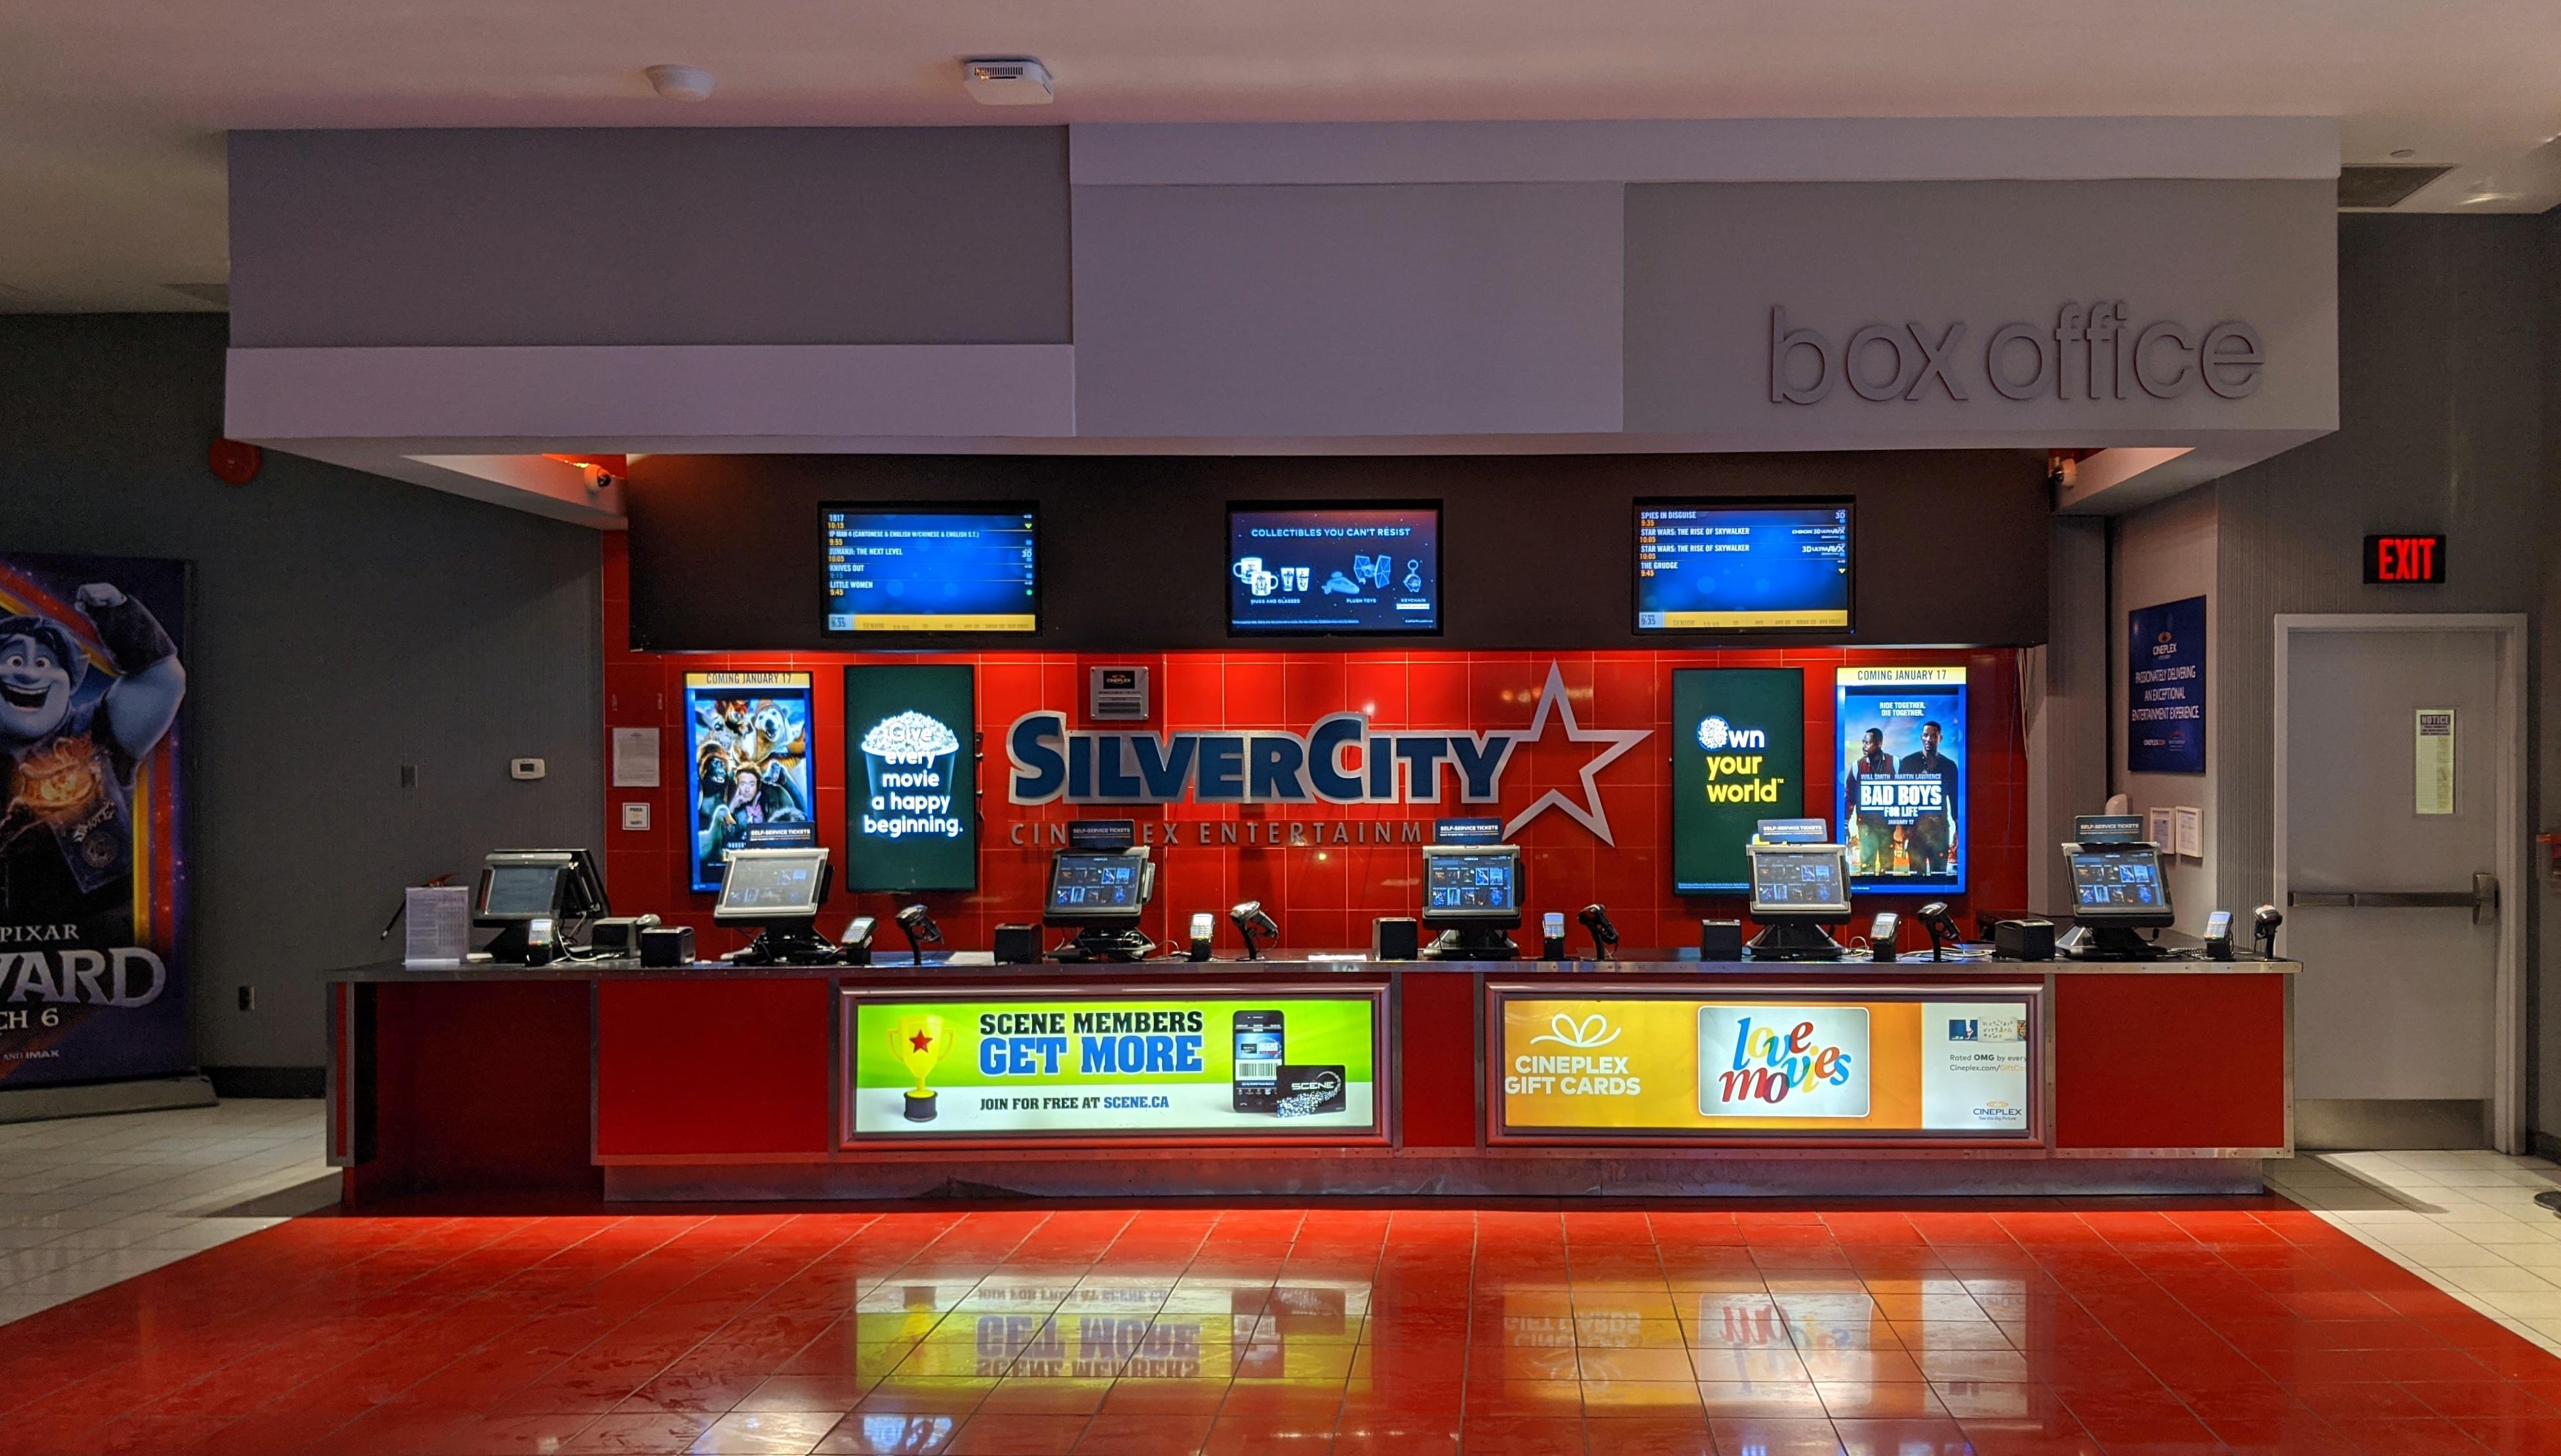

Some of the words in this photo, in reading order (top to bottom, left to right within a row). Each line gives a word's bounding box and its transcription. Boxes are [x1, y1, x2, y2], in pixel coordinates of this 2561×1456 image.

[1770, 303, 1969, 404] box
[1987, 301, 2265, 401] office
[2379, 538, 2436, 580] EXIT
[2153, 643, 2177, 656] CINEPLEX
[707, 673, 740, 684] COMING
[742, 673, 778, 684] JANUARY
[782, 673, 791, 684] 17
[1857, 670, 1892, 681] COMING
[1895, 670, 1934, 680] JANUARY
[1937, 670, 1947, 680] 17
[2135, 669, 2167, 683] PASSIONATELY
[2168, 665, 2196, 681] DELIVERING
[2144, 688, 2153, 701] AN
[2153, 686, 2185, 701] EXCEPTIONAL
[2132, 707, 2169, 721] ENTERTAINMENT
[2170, 705, 2200, 719] EXPERIENCE
[2421, 715, 2450, 724] NOTICE
[888, 722, 933, 741] Give
[885, 751, 936, 769] every
[1706, 756, 1762, 781] your
[883, 770, 940, 787] movie
[872, 797, 884, 810] a
[890, 791, 950, 814] happy
[1861, 785, 1894, 806] BAD
[1897, 785, 1942, 806] BOYS
[1884, 806, 1899, 817] FOR
[1901, 806, 1918, 817] LIFE
[864, 815, 964, 838] beginning.
[1011, 823, 1178, 845] CINEX
[0, 924, 79, 942] PIXAR
[41, 1008, 59, 1027] 6
[980, 1012, 1065, 1035] SCENE
[1073, 1011, 1202, 1034] MEMBERS
[1732, 1017, 1814, 1071] love
[25, 1050, 60, 1059] IMAX
[980, 1036, 1067, 1075] GET
[1081, 1034, 1203, 1074] MORE
[1515, 1055, 1629, 1074] CINEPLEX
[1718, 1045, 1852, 1105] movies
[1291, 1082, 1334, 1090] SCENE
[1505, 1076, 1556, 1094] GIFT
[1560, 1077, 1640, 1095] CARDS
[980, 1098, 1008, 1111] JOIN
[1012, 1098, 1039, 1110] FOR
[1043, 1097, 1079, 1110] FREE
[1082, 1097, 1100, 1109] AT
[1103, 1095, 1170, 1109] SCENE.CA
